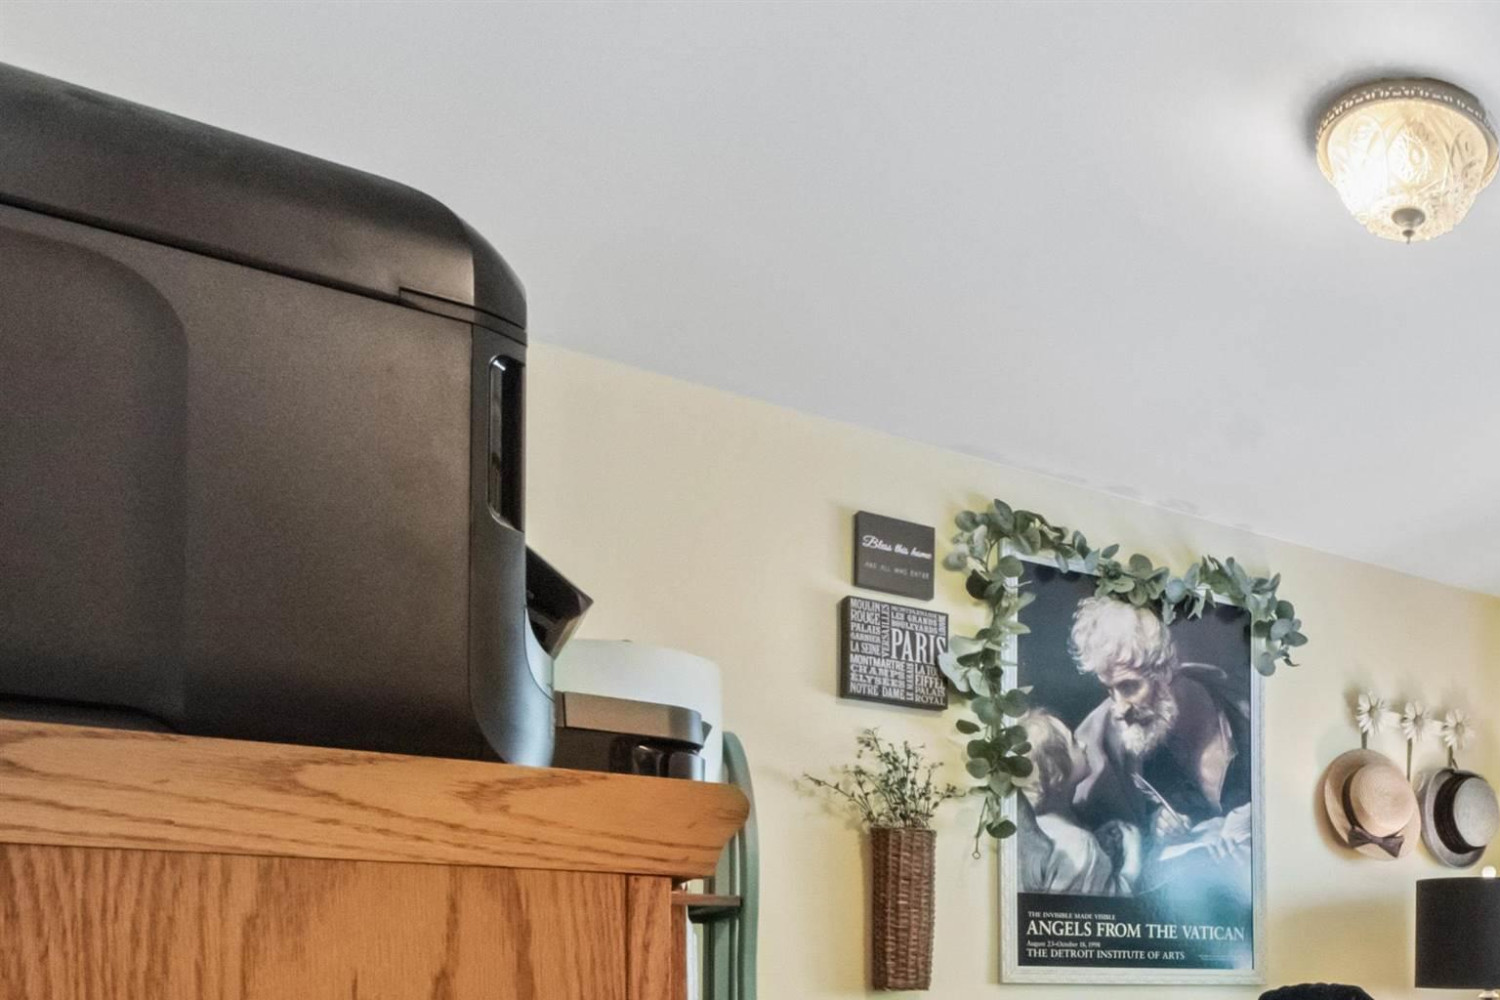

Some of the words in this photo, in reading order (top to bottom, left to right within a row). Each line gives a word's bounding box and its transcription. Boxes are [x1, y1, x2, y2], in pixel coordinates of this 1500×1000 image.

[862, 534, 892, 552] Bless
[894, 543, 909, 555] this
[850, 597, 881, 613] MOULIN
[850, 608, 881, 626] ROUGE
[850, 621, 881, 635] PALAIS
[881, 603, 890, 659] VERSAILLES
[890, 627, 946, 665] PARIS
[850, 653, 905, 672] MONTMARTRE
[850, 663, 905, 680] CHAMPS
[850, 681, 879, 696] NOTRE
[881, 685, 905, 700] DAME
[915, 694, 946, 706] ROYAL
[1043, 911, 1072, 919] INVISIBLE
[1074, 912, 1092, 920] MADE
[1026, 920, 1092, 936] ANGELS
[1096, 922, 1141, 938] FROM
[1145, 923, 1178, 939] THE
[1182, 925, 1245, 941] VATICAN
[1026, 948, 1048, 958] THE
[1050, 948, 1095, 958] DETROIT
[1096, 949, 1145, 959] INSTITUTE
[1147, 950, 1160, 960] OF
[1162, 951, 1185, 960] ARTS
